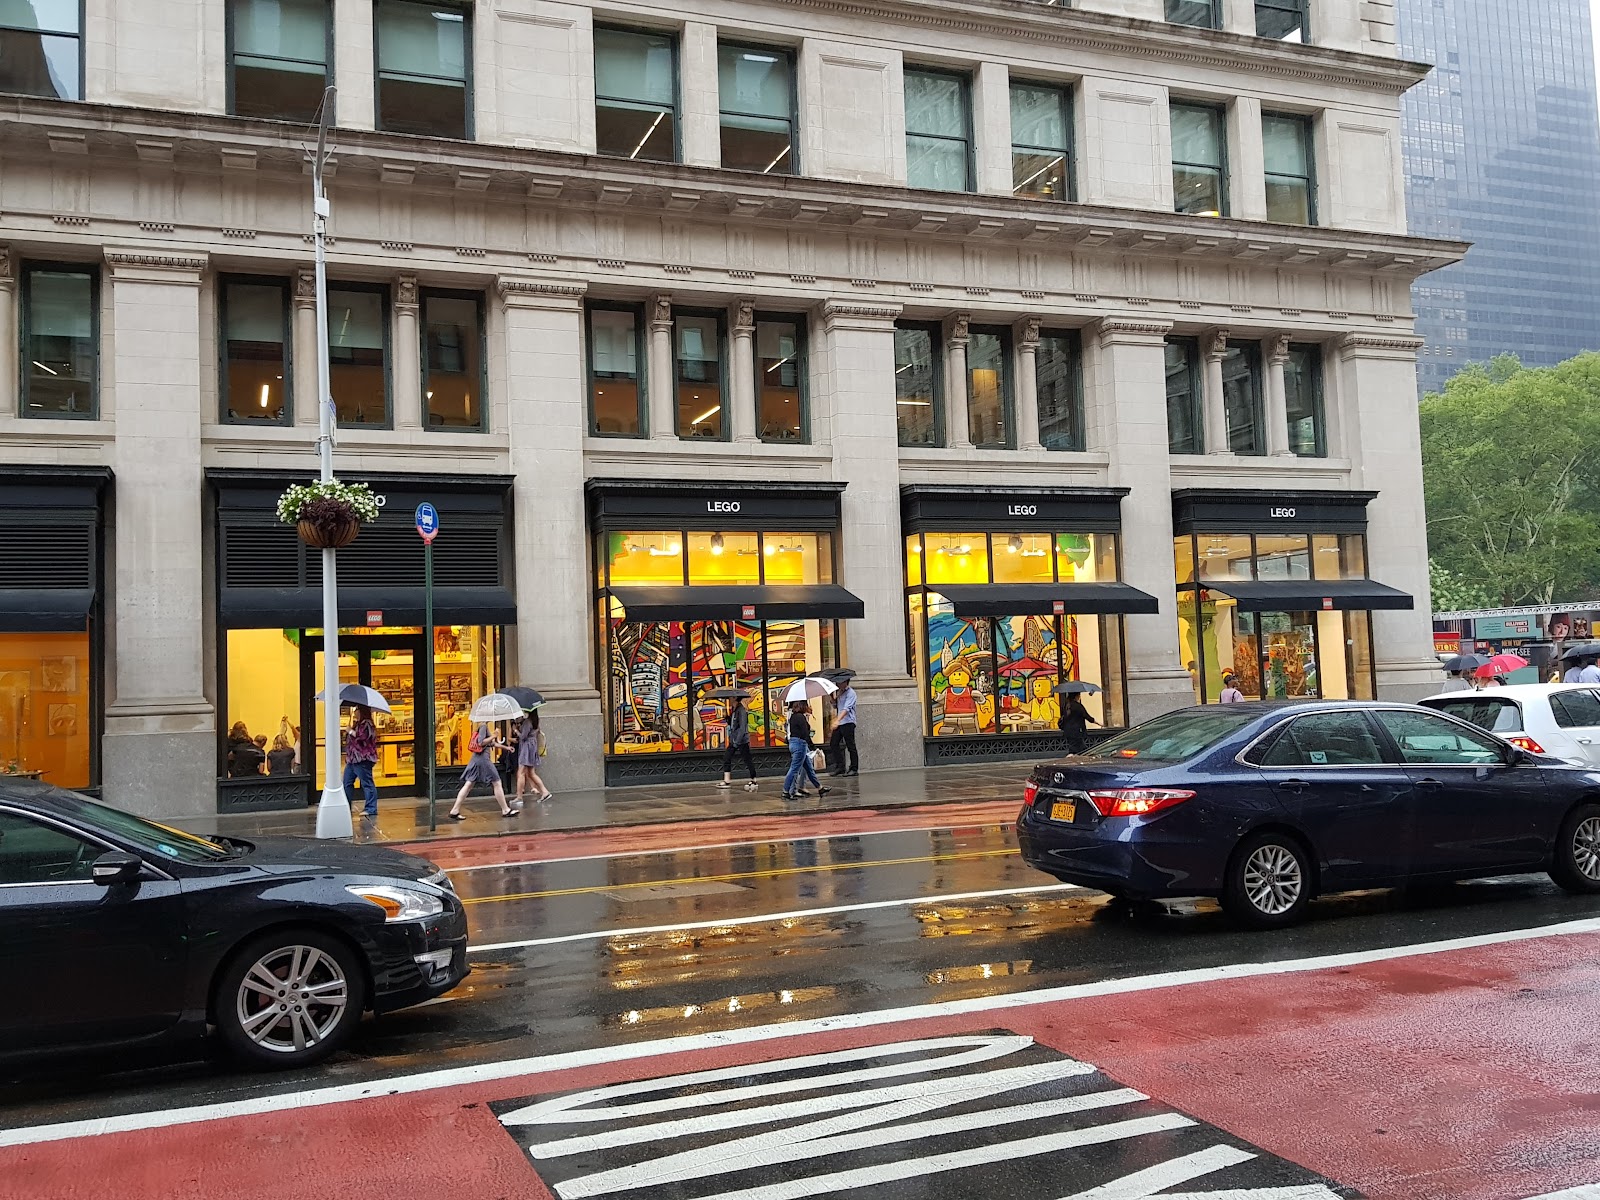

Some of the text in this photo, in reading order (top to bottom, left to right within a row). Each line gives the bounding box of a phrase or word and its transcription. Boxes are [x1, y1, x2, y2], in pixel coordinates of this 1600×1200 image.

[707, 501, 741, 512] LEGO
[1008, 505, 1037, 515] LEGO
[1270, 508, 1296, 518] LEGO
